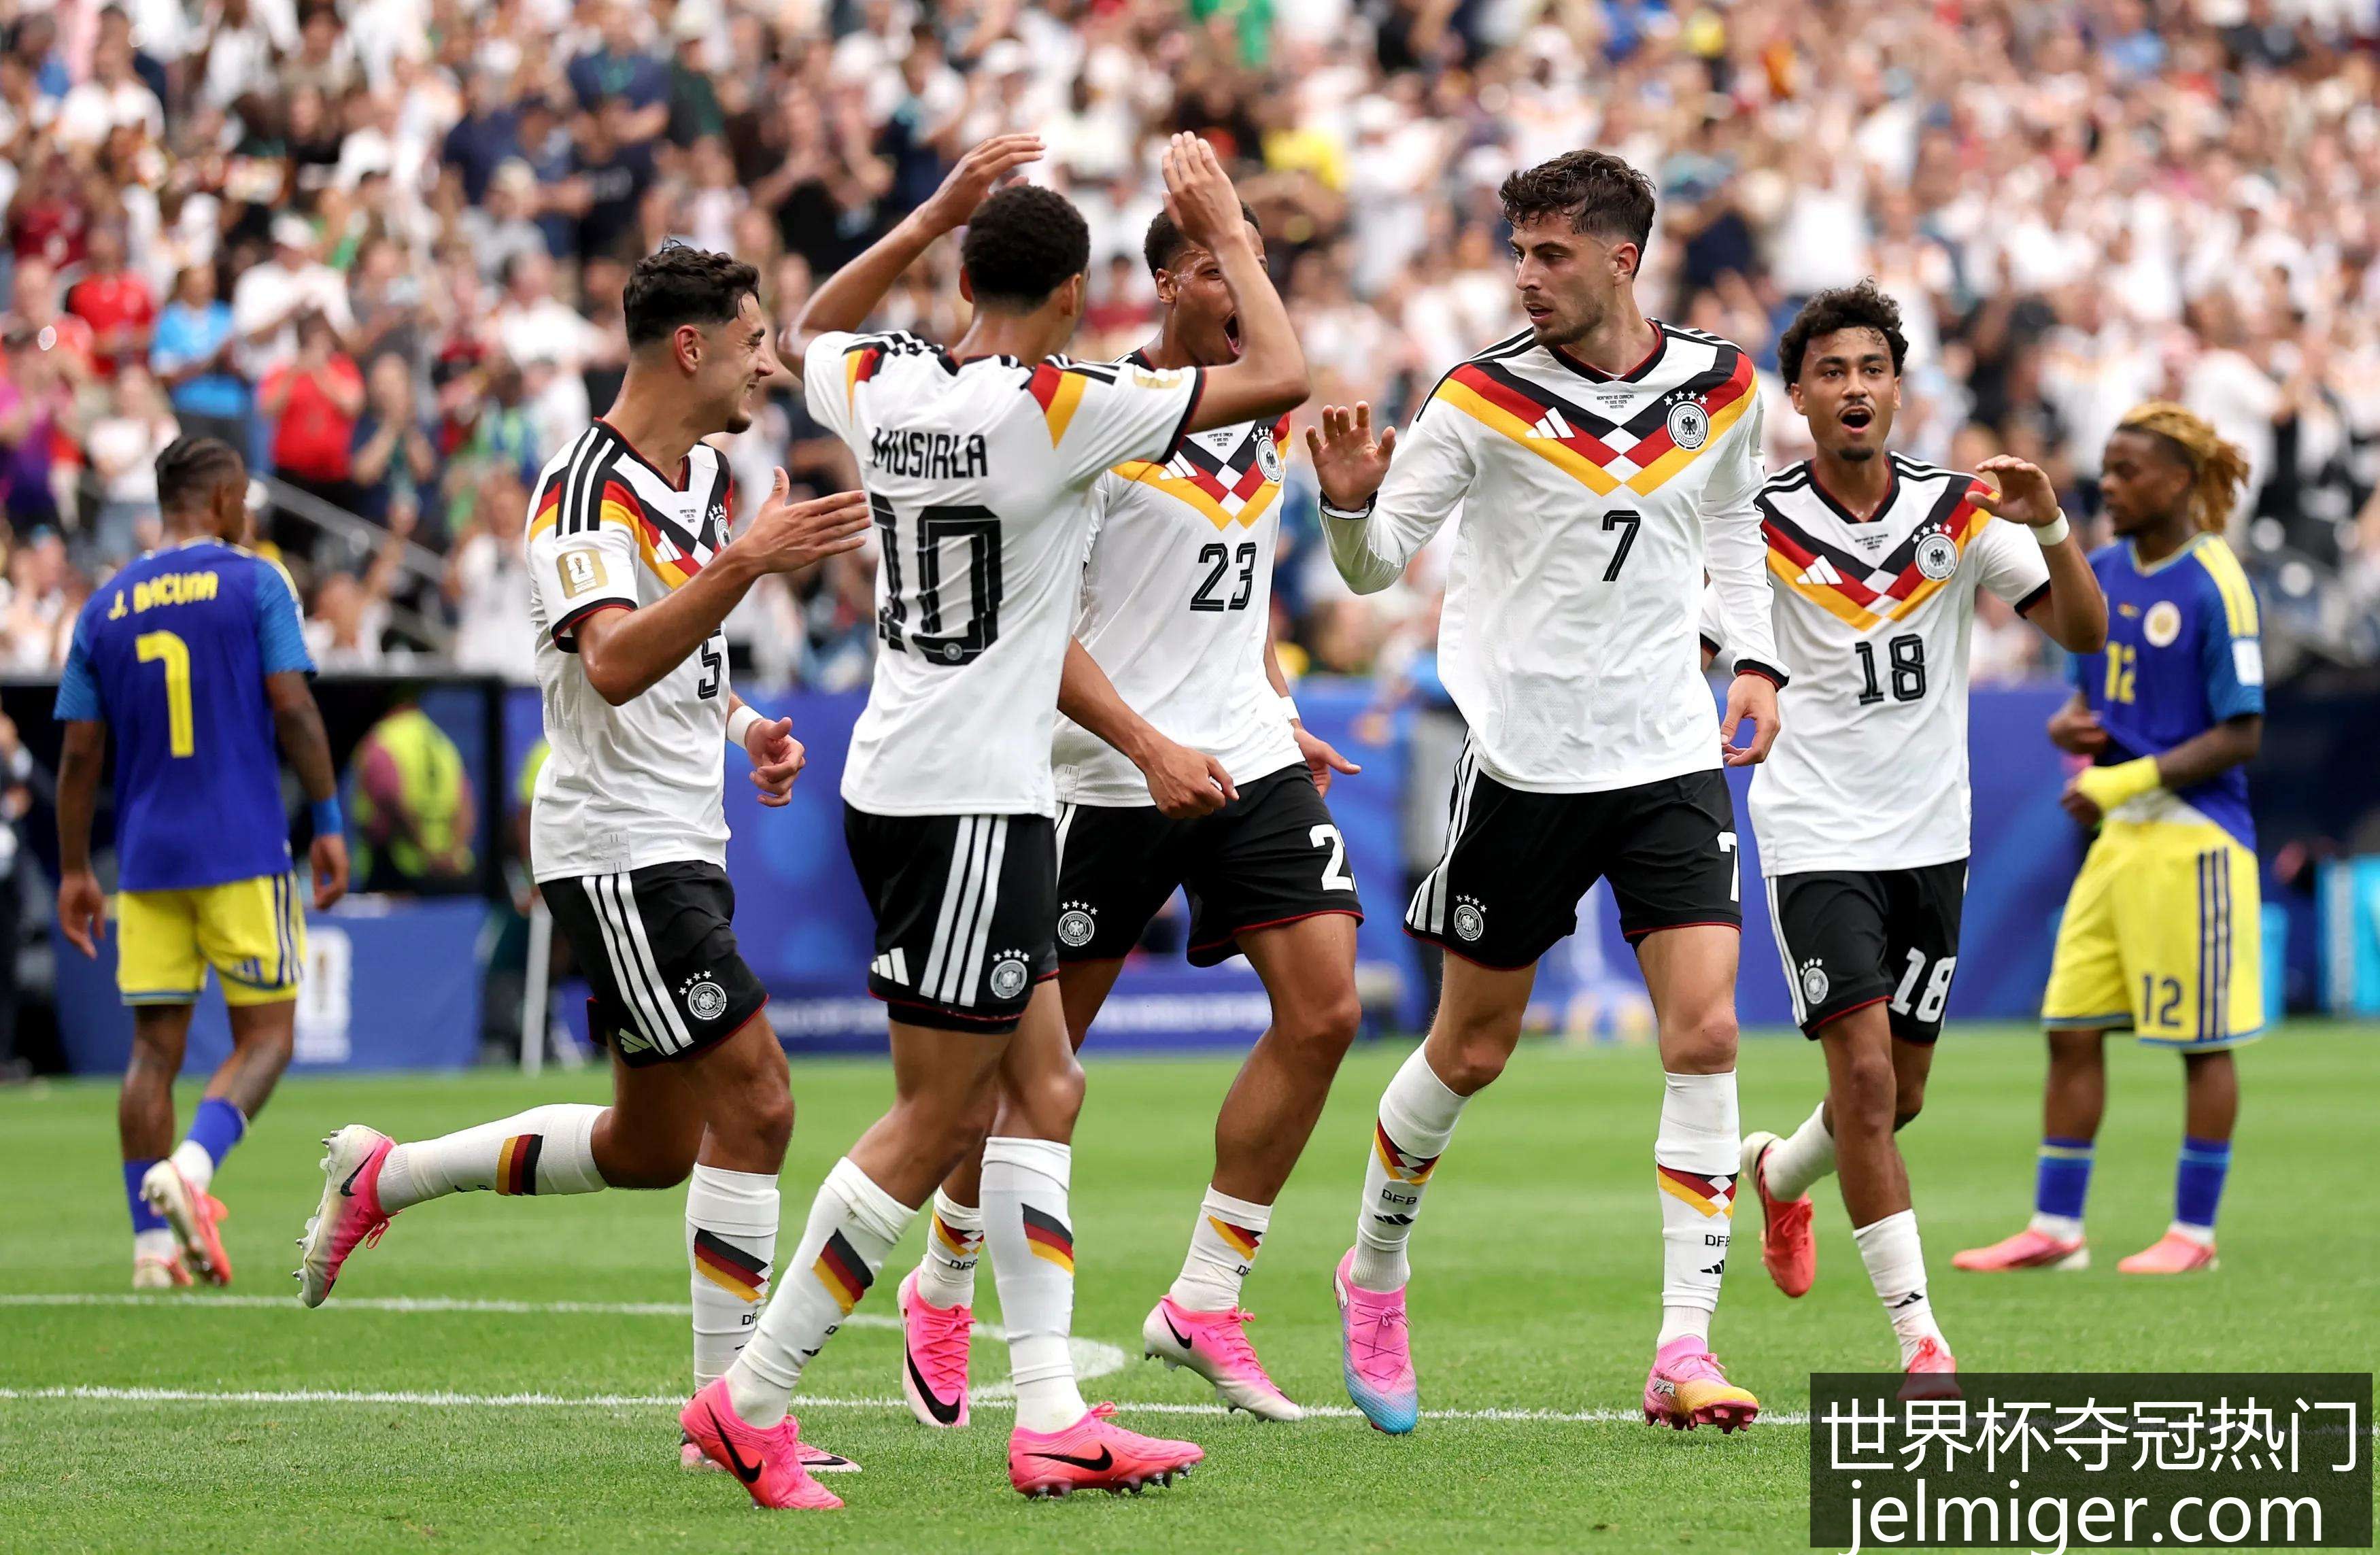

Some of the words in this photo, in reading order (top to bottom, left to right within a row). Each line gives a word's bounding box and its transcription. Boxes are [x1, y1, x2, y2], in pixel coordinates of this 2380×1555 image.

[871, 427, 988, 479] MUSIALA
[871, 493, 1003, 666] 10
[1189, 541, 1257, 612] 23
[1601, 509, 1641, 582] 7
[107, 591, 128, 621] J.
[133, 570, 219, 614] BACUNA
[135, 630, 195, 758] 7
[698, 630, 722, 700] 5
[1854, 633, 1926, 706] 18
[2104, 640, 2137, 704] 12
[1309, 824, 1359, 895] 2
[1716, 831, 1741, 903] 7
[1888, 946, 1957, 1023] 18
[2141, 973, 2182, 1027] 12
[1382, 1188, 1417, 1205] DFB
[1705, 1234, 1731, 1247] DFB
